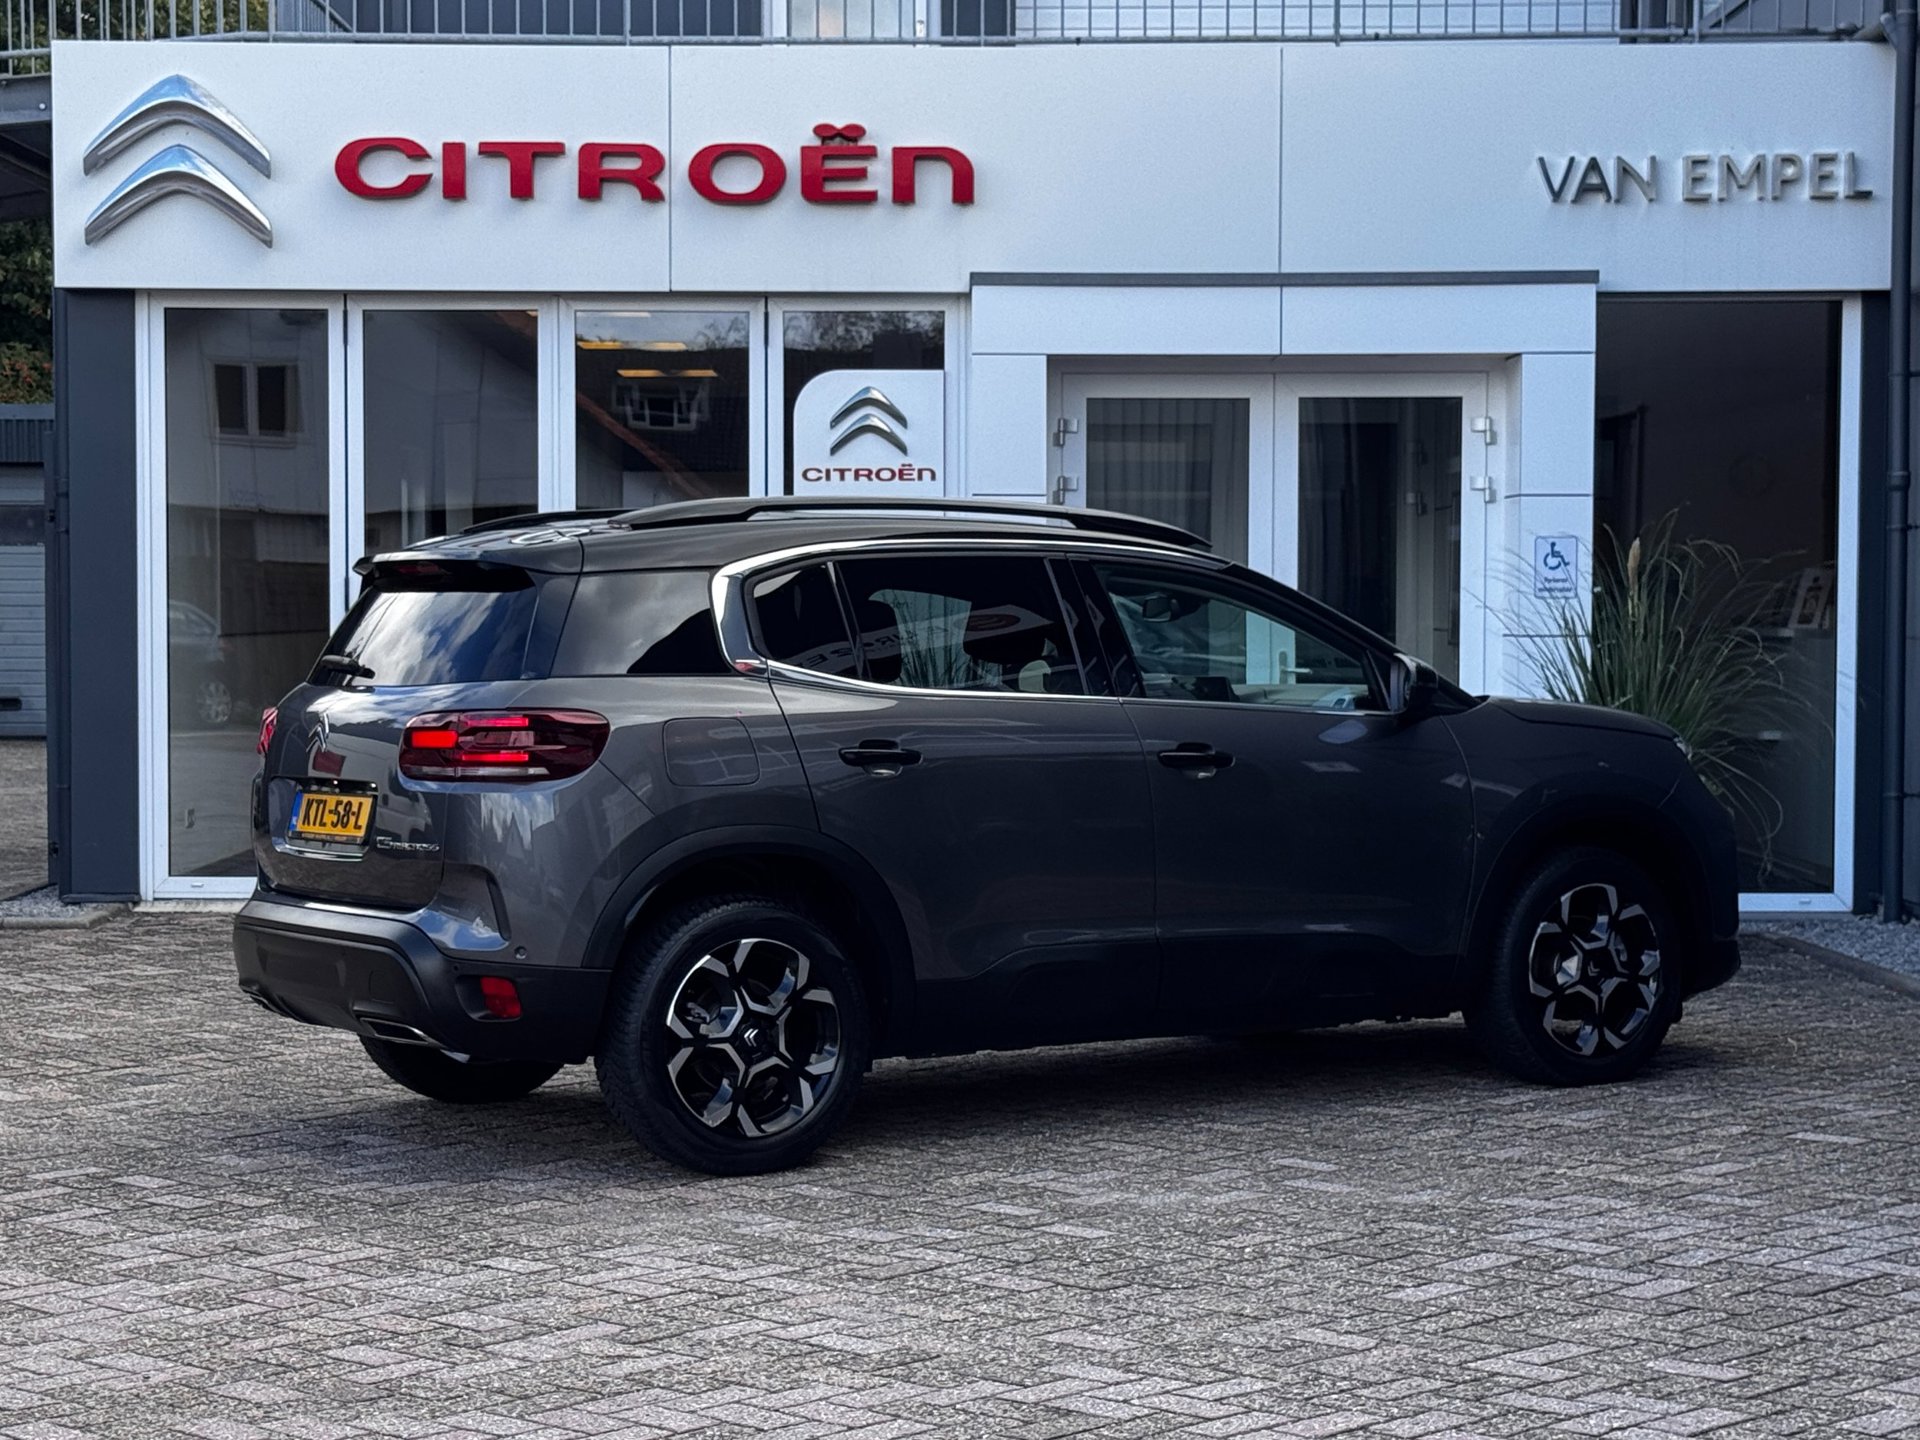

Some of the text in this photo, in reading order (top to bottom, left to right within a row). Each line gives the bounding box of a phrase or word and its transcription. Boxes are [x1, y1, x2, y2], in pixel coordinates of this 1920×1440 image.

[1537, 152, 1873, 203] VAN EMPEL
[301, 797, 364, 830] KTL-58-L
